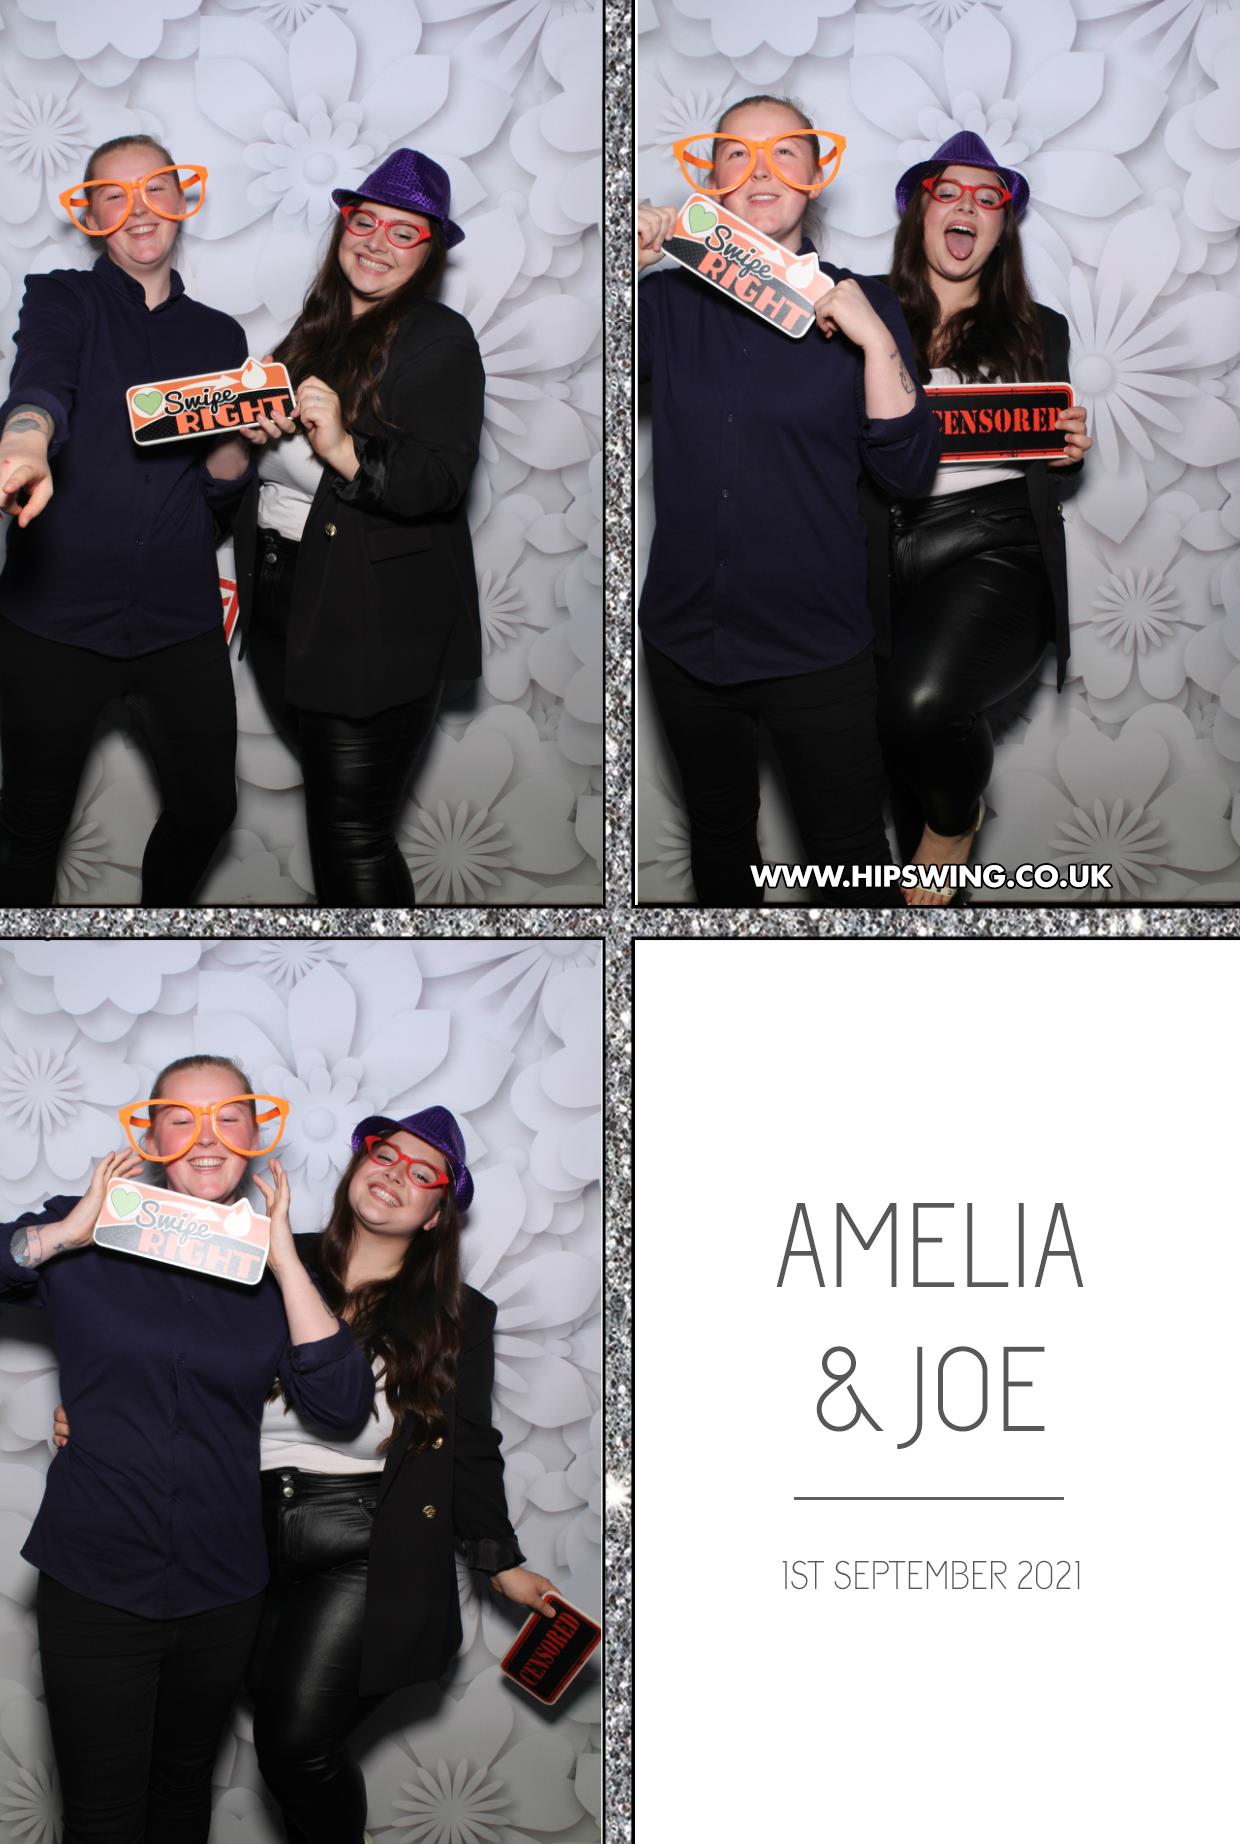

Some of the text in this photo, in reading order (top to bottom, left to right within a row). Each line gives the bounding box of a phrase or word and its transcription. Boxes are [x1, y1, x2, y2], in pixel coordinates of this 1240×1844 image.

[704, 225, 773, 279] Swipe
[697, 252, 811, 331] RIGHT
[164, 388, 237, 415] Swipe
[176, 394, 290, 434] RIGHT
[135, 1200, 211, 1246] Swipe
[138, 1229, 261, 1280] RIGHT
[519, 1612, 580, 1687] CENSORED
